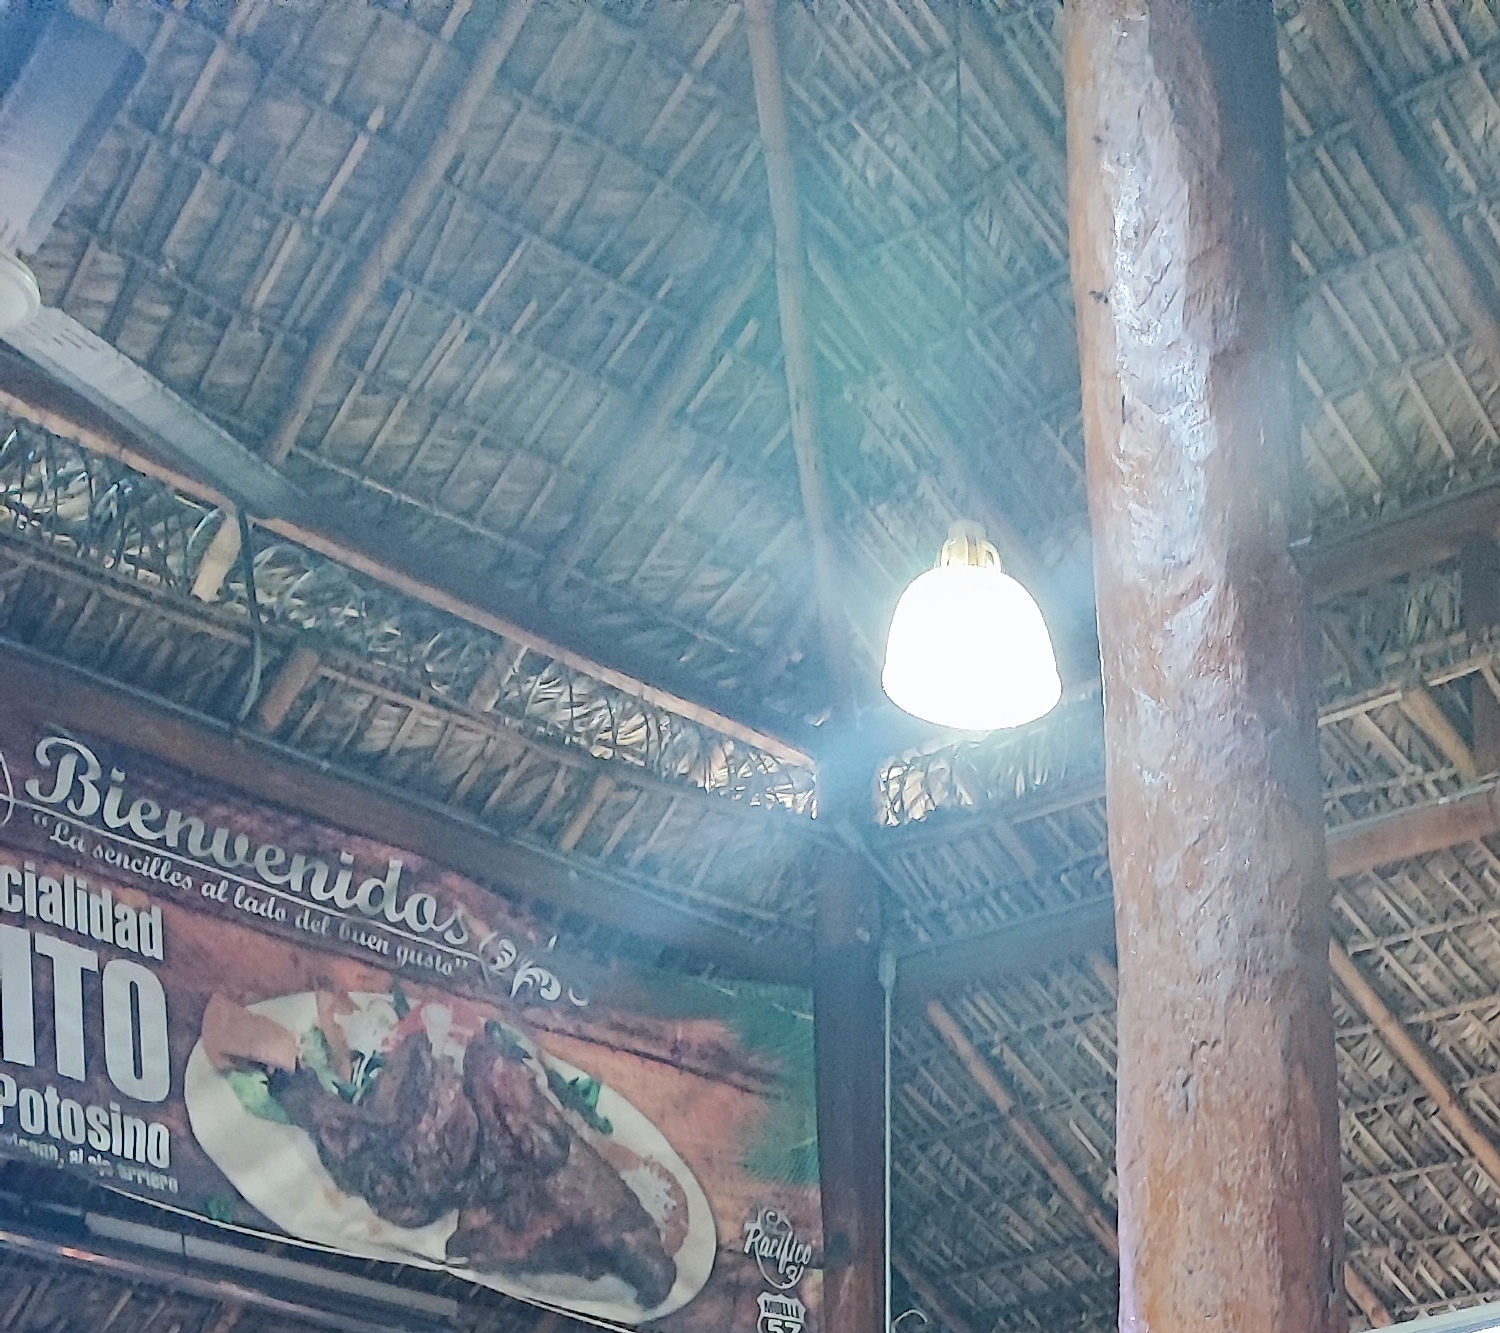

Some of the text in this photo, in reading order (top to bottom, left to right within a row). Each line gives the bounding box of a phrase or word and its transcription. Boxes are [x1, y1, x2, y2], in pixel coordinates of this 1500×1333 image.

[25, 736, 470, 946] Bienvenidos
[92, 842, 194, 891] sencilles
[201, 879, 229, 904] al
[234, 883, 288, 923] lado
[294, 908, 331, 936] del
[338, 918, 390, 956] buen
[0, 1072, 171, 1169] Potosino
